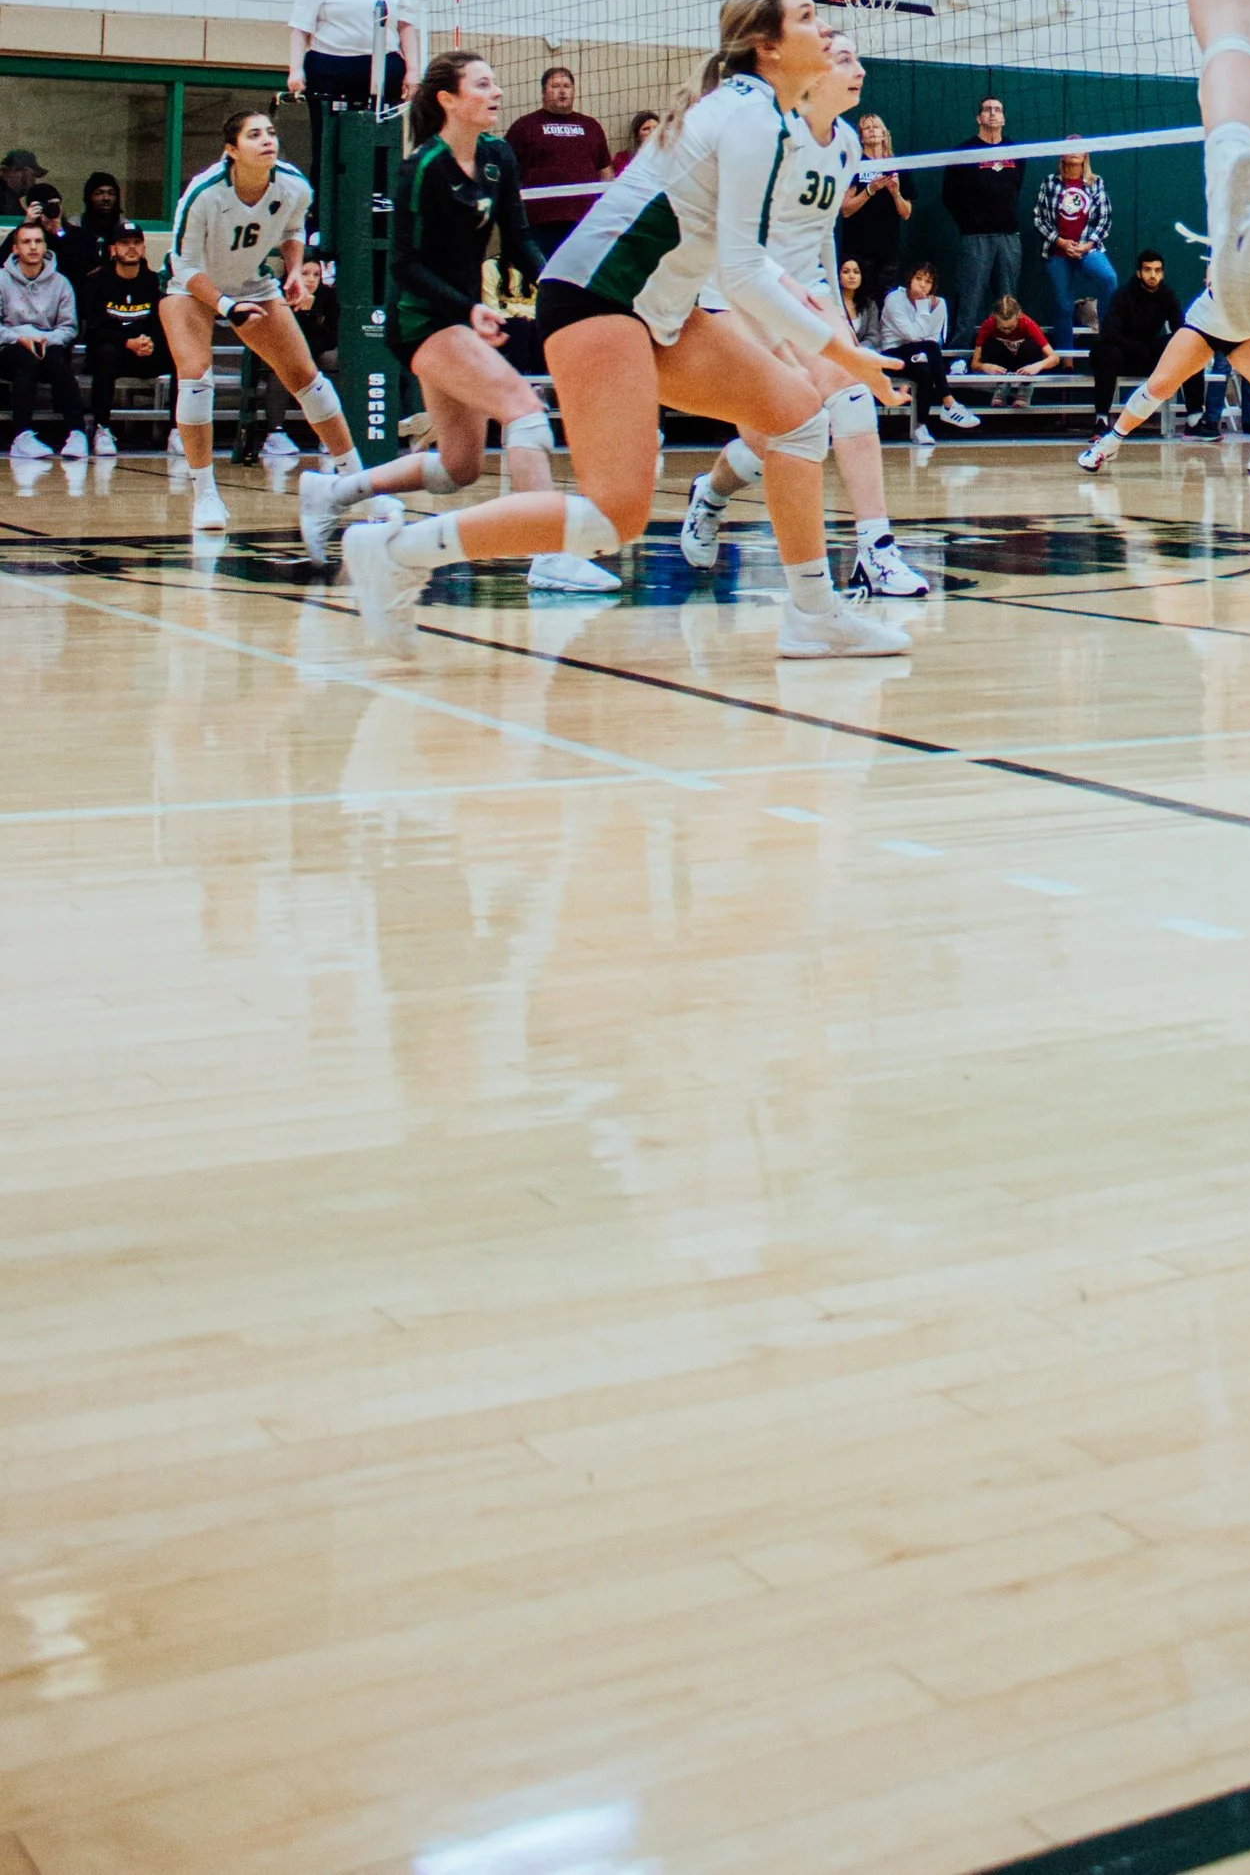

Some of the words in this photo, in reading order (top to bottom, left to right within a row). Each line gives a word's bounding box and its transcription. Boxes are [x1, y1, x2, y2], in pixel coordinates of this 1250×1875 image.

[542, 126, 586, 136] KOKOMO
[798, 170, 846, 211] 30
[230, 222, 261, 252] 16
